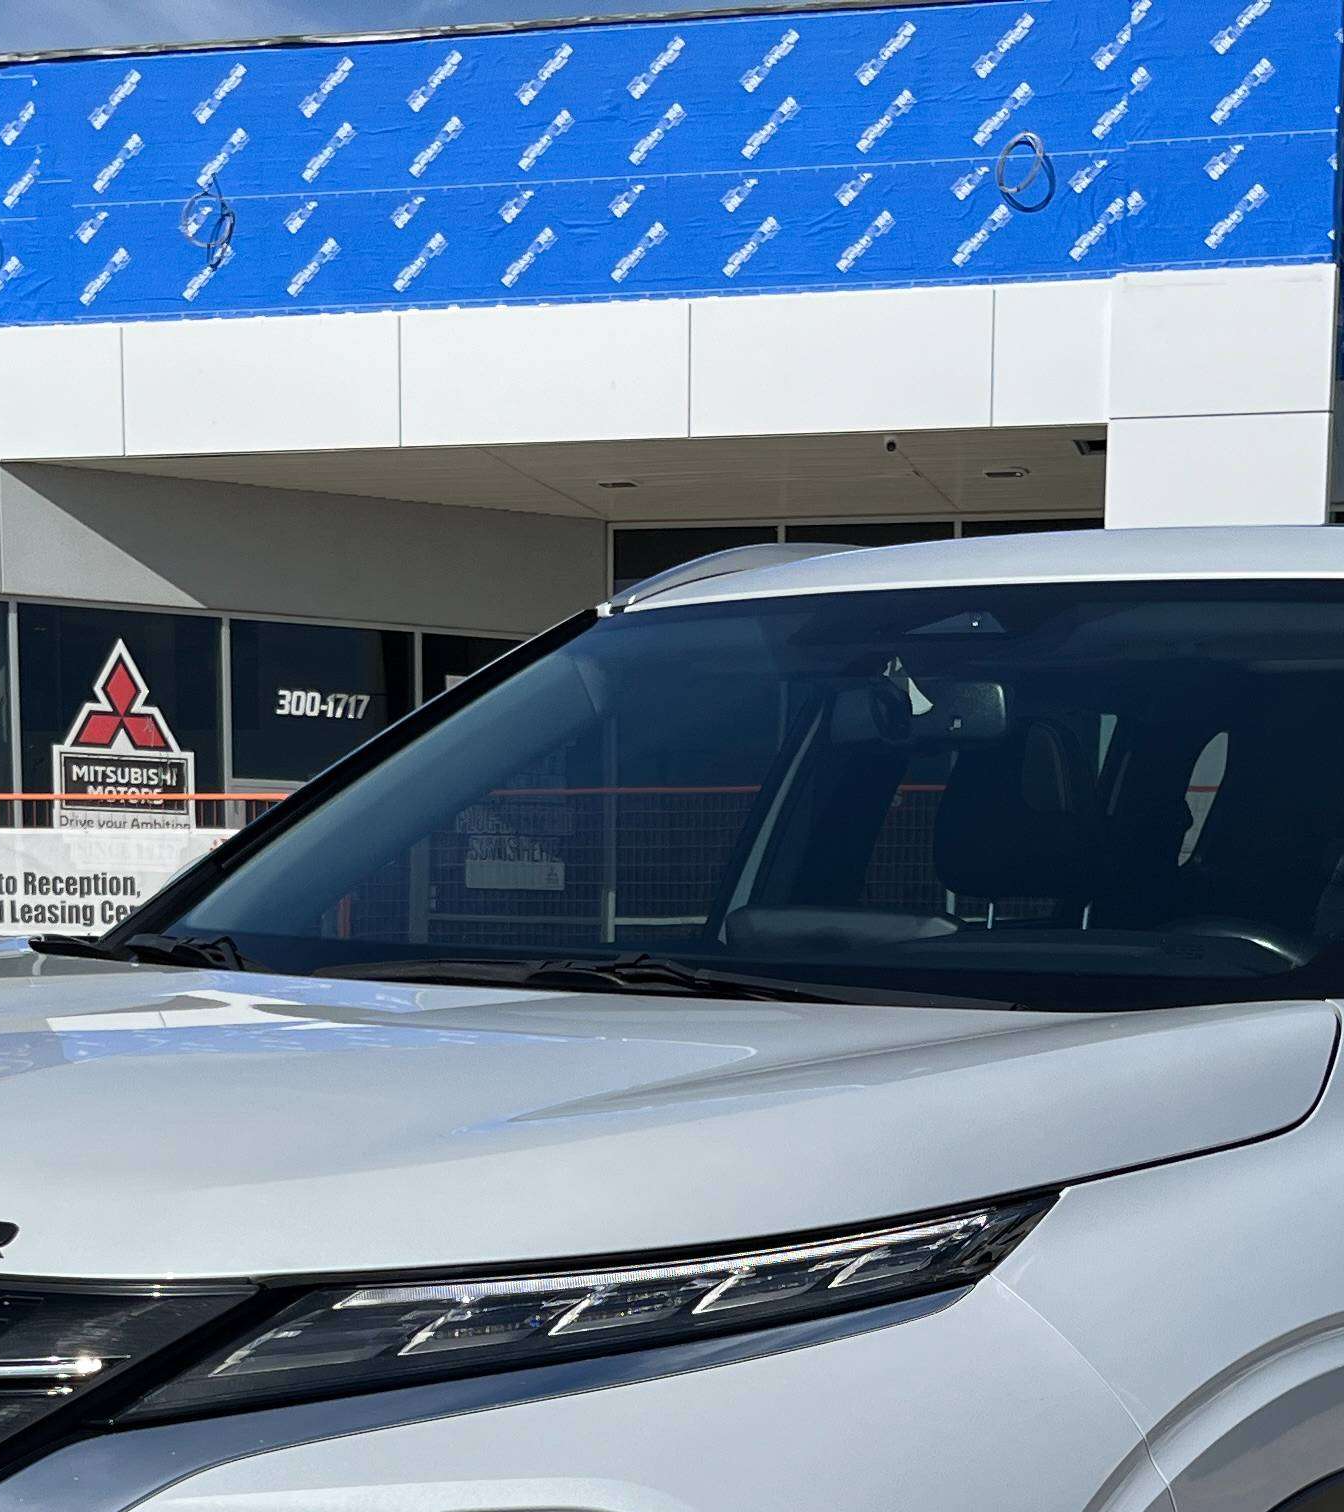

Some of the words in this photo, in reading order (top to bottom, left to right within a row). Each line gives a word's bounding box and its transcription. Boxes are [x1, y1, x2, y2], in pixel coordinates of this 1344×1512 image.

[276, 689, 371, 719] 300-1717
[71, 764, 177, 787] MITSUBISHI
[59, 815, 95, 830] Drive
[23, 871, 142, 899] Reception,
[10, 900, 96, 927] Leasing
